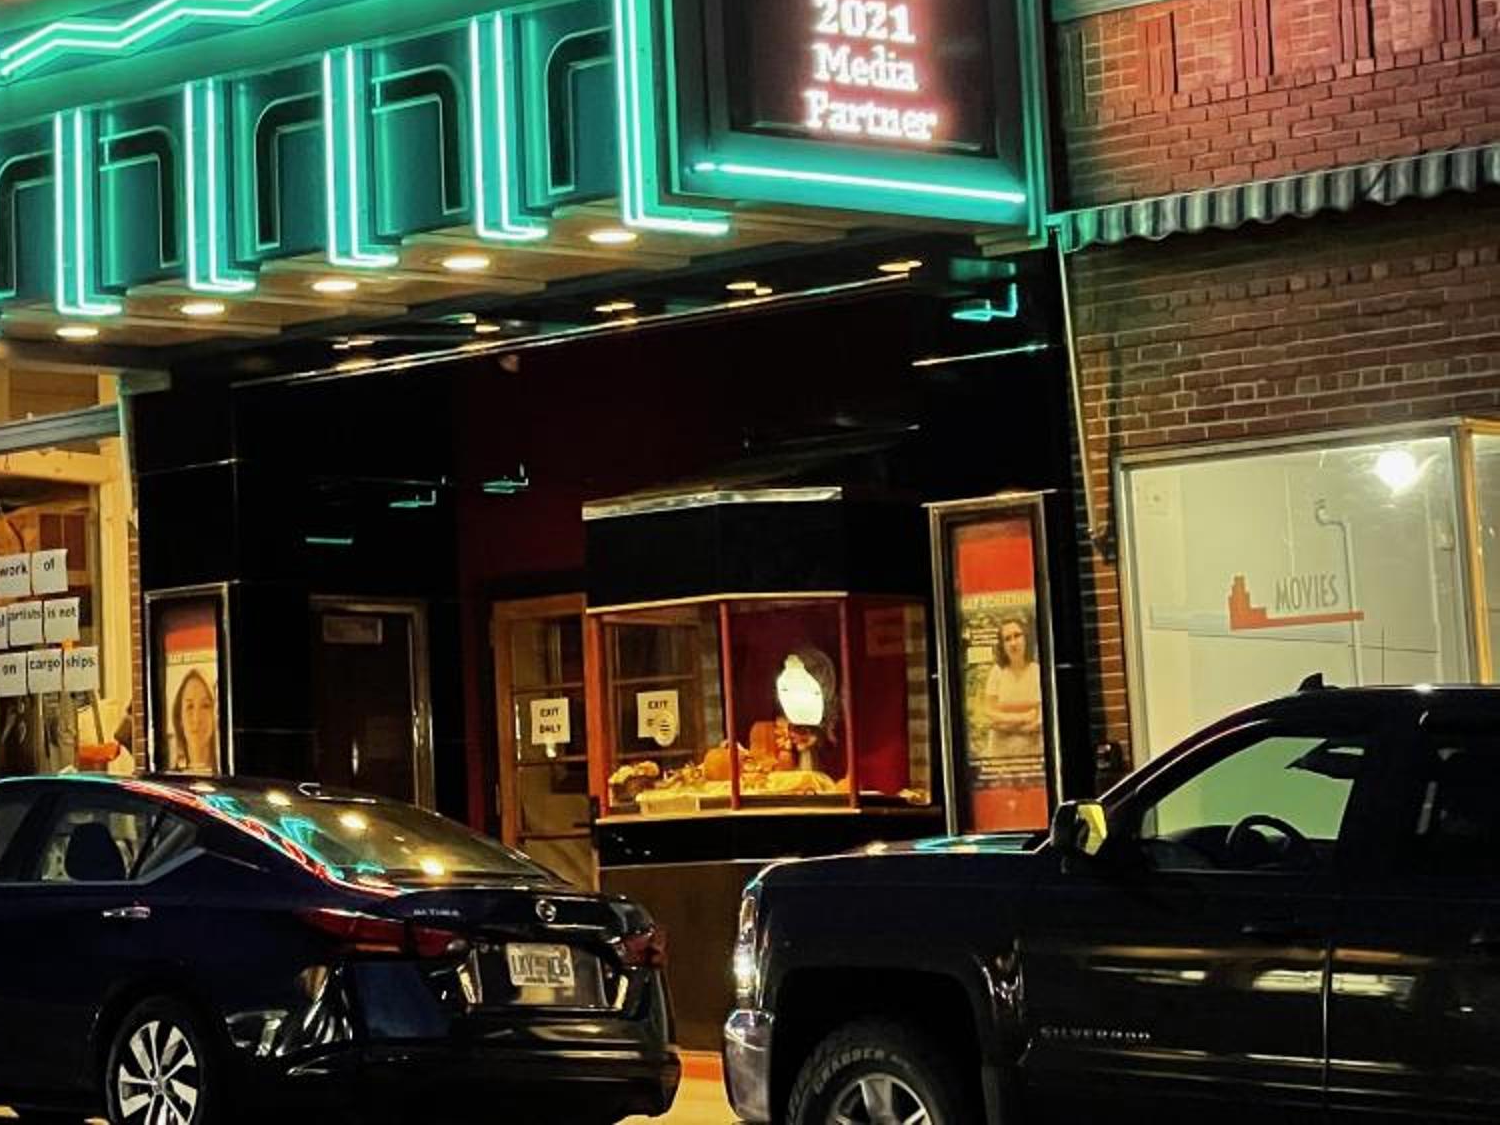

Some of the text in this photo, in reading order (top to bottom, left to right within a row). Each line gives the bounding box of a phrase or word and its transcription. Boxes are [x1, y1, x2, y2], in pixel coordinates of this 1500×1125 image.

[812, 43, 919, 91] Media
[804, 90, 938, 140] Partner
[43, 558, 56, 571] of
[1275, 574, 1339, 612] MOVIES
[8, 609, 42, 622] artists
[47, 609, 57, 618] is
[59, 606, 77, 619] not
[3, 663, 18, 675] on
[29, 658, 62, 672] cargo
[648, 700, 668, 709] EXIT
[540, 708, 560, 718] EXIT
